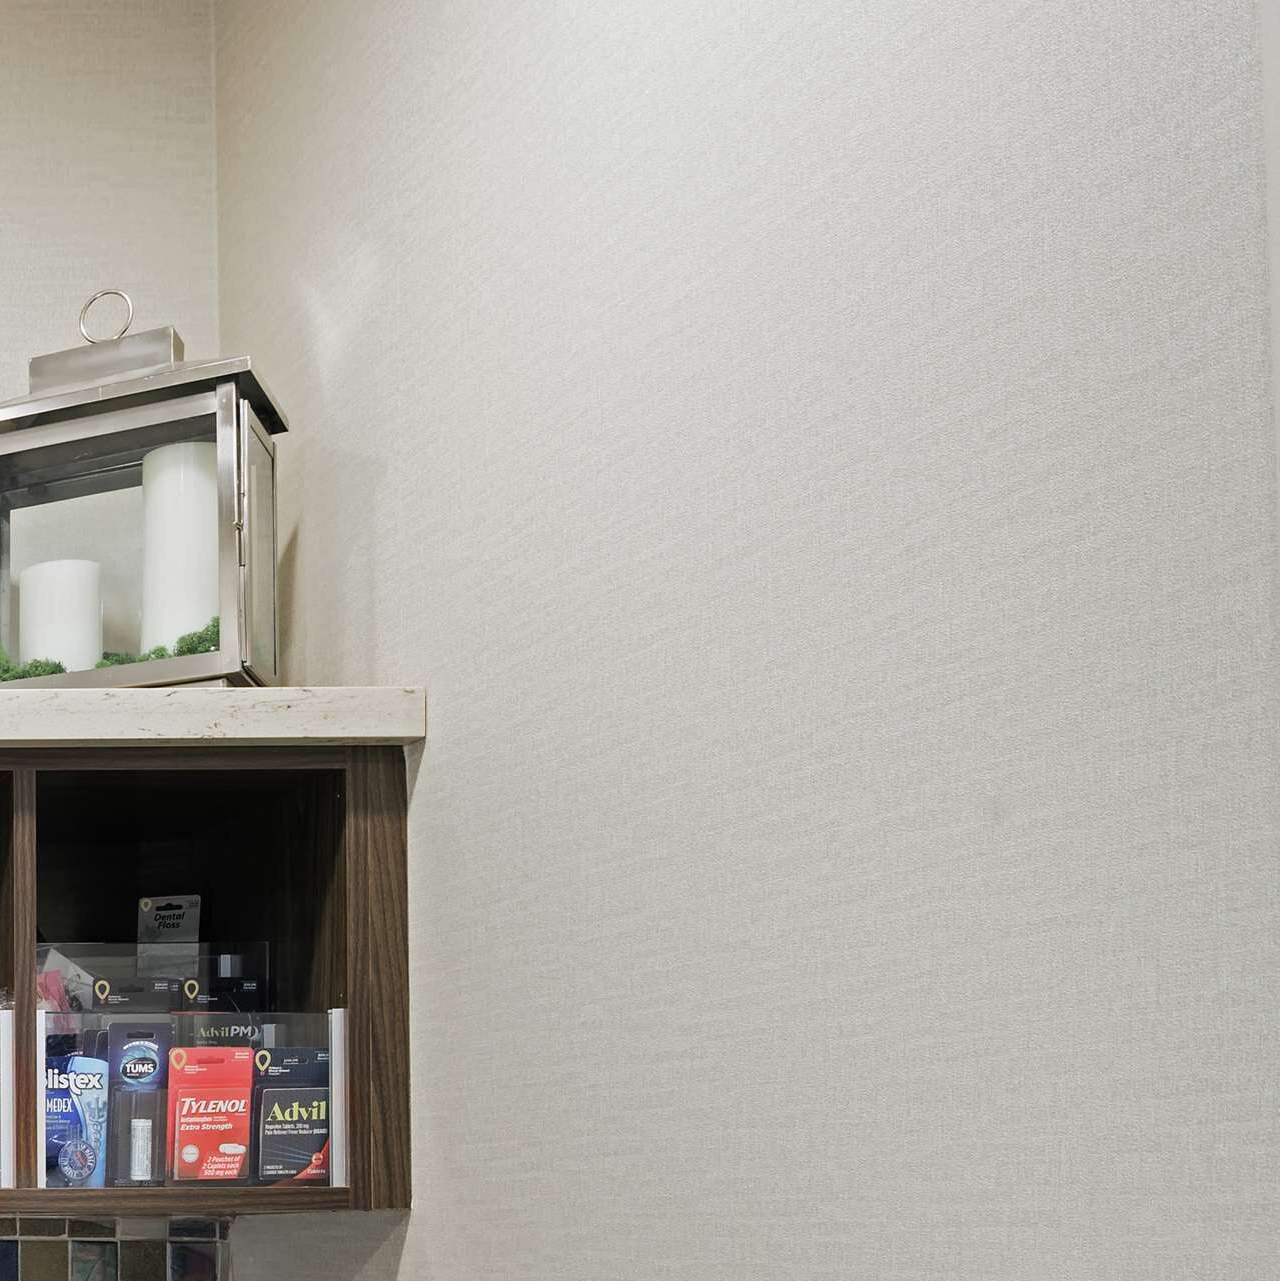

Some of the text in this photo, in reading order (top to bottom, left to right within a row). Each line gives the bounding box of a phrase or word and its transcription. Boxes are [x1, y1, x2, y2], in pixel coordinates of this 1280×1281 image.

[153, 911, 185, 922] Dental
[157, 921, 181, 930] Floss
[198, 1025, 253, 1037] Advil PM
[125, 1062, 155, 1074] TUMS
[45, 1068, 103, 1095] listex
[46, 1097, 73, 1113] MEDEX
[180, 1097, 247, 1115] TYLENOL
[266, 1100, 327, 1121] Advil
[180, 1123, 233, 1132] Extra Strength
